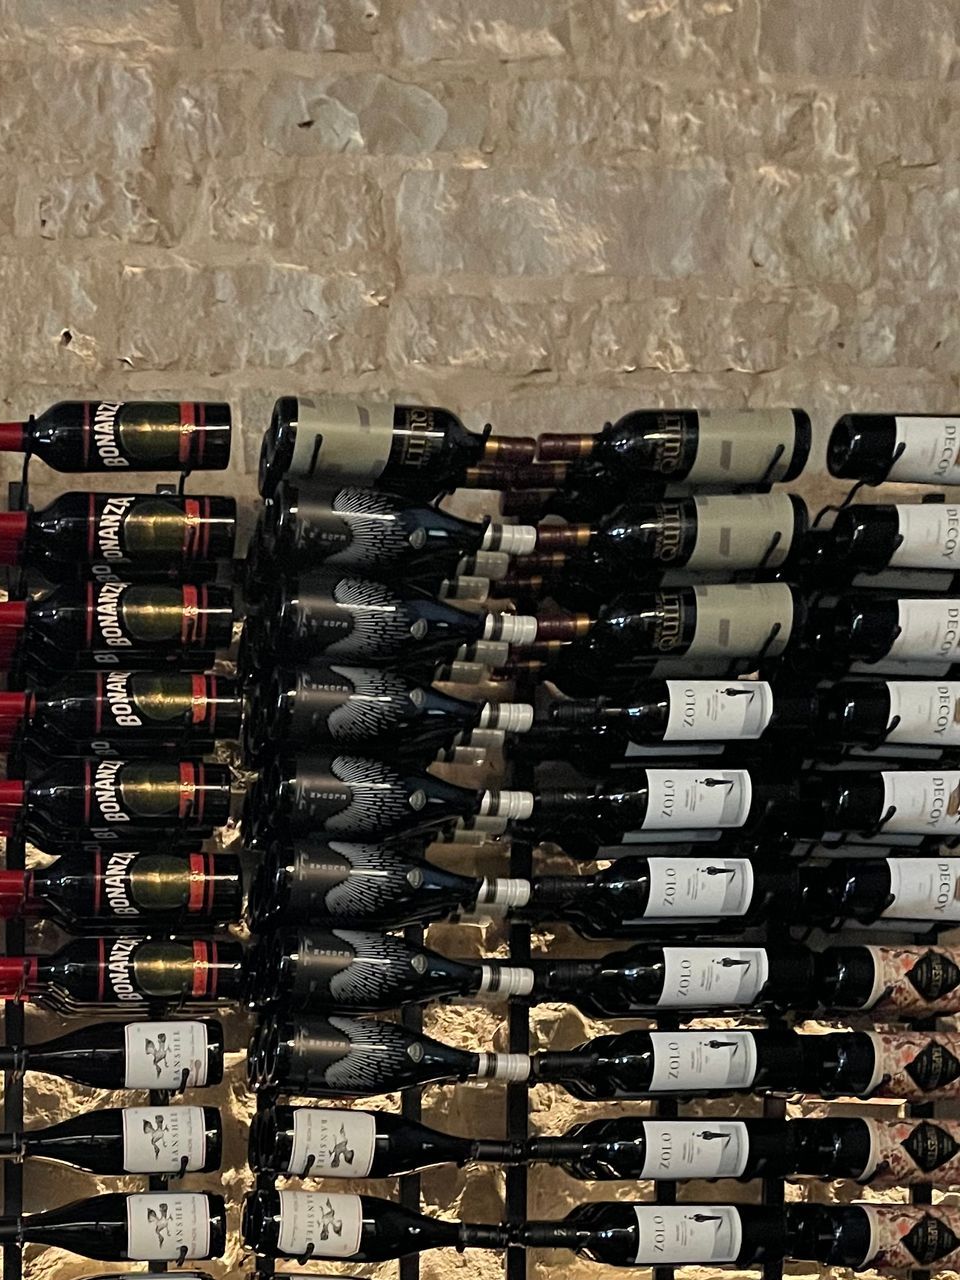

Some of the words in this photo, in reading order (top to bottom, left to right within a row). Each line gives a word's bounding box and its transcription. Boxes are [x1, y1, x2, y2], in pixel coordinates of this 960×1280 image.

[404, 409, 428, 467] QUILT
[659, 412, 681, 474] QUILT
[933, 425, 957, 477] DECOY
[659, 503, 680, 561] QUILT
[942, 509, 959, 561] DECOY
[658, 593, 679, 651] QUILT
[936, 607, 960, 657] DECOY
[681, 689, 696, 727] ZOLO
[933, 686, 950, 736] DECOY
[310, 792, 347, 801] ELOUAN
[661, 779, 675, 817] ZOLO
[926, 777, 945, 828] DECOY
[105, 851, 141, 914] BONANZA
[662, 868, 677, 906] ZOLO
[934, 863, 951, 914] DECOY
[108, 938, 144, 1000] BONANZA
[676, 959, 691, 997] ZOLO
[172, 1030, 181, 1081] BANSHEE
[667, 1041, 680, 1080] ZOLO
[171, 1112, 179, 1163] BANSHEE
[316, 1119, 328, 1169] BANSHEE
[658, 1132, 672, 1170] ZOLO
[653, 1215, 666, 1252] ZOLO
